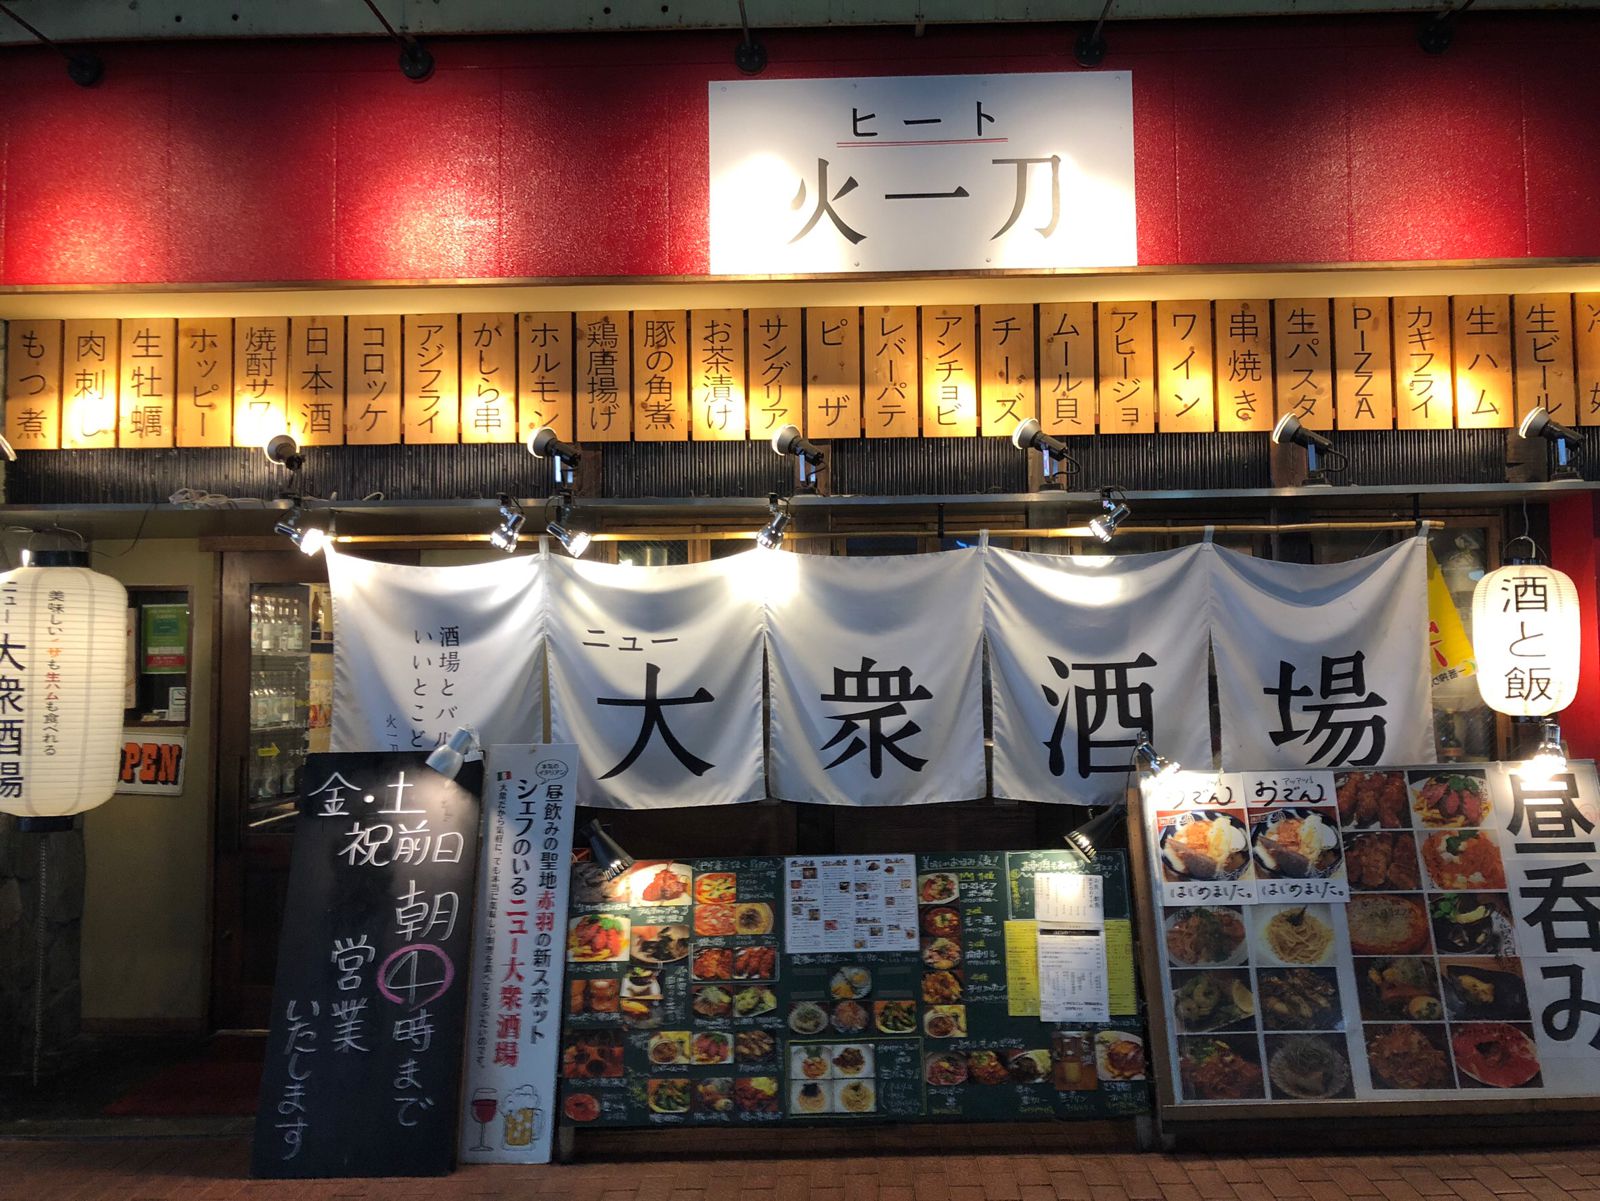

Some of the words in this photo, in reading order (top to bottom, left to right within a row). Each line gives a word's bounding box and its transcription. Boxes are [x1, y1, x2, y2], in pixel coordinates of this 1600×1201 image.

[853, 101, 994, 137] ヒート
[787, 155, 1061, 245] 火一刀
[18, 329, 47, 439] もつ煮
[131, 328, 163, 439] 生牡蠣
[190, 327, 219, 437] ホッピー
[302, 327, 334, 434] 日本酒
[360, 327, 388, 433] コロッケ
[417, 323, 444, 434] アジフライ
[530, 327, 560, 426] ホルモン
[587, 321, 619, 433] 鶏唐揚げ
[645, 320, 675, 431] 豚の角煮
[702, 319, 735, 431] お茶漬け
[759, 319, 789, 431] サングリア
[820, 318, 851, 428] ピザ
[878, 316, 908, 429] レバーパテ
[936, 315, 965, 428] アンチョビ
[993, 315, 1024, 425] チーズ
[1052, 313, 1082, 427] ムール貝
[1111, 311, 1140, 425] アヒージョ
[1172, 313, 1201, 420] ワイン
[1229, 310, 1261, 422] 串焼き
[1287, 308, 1320, 420] 生パスタ
[1353, 307, 1376, 421] PIZZA
[1408, 306, 1436, 420] カキフライ
[1466, 305, 1500, 418] 生ハム
[1526, 304, 1564, 417] 生ビール
[583, 627, 680, 652] ニュー
[1501, 576, 1552, 702] 酒と飯
[124, 742, 181, 786] PEN
[1255, 780, 1325, 807] おでん
[337, 818, 464, 866] 祝前日
[1170, 885, 1253, 902] はじめました。
[1262, 882, 1345, 900] はじめました。
[330, 934, 376, 1053] 営業
[275, 1000, 319, 1161] いたします
